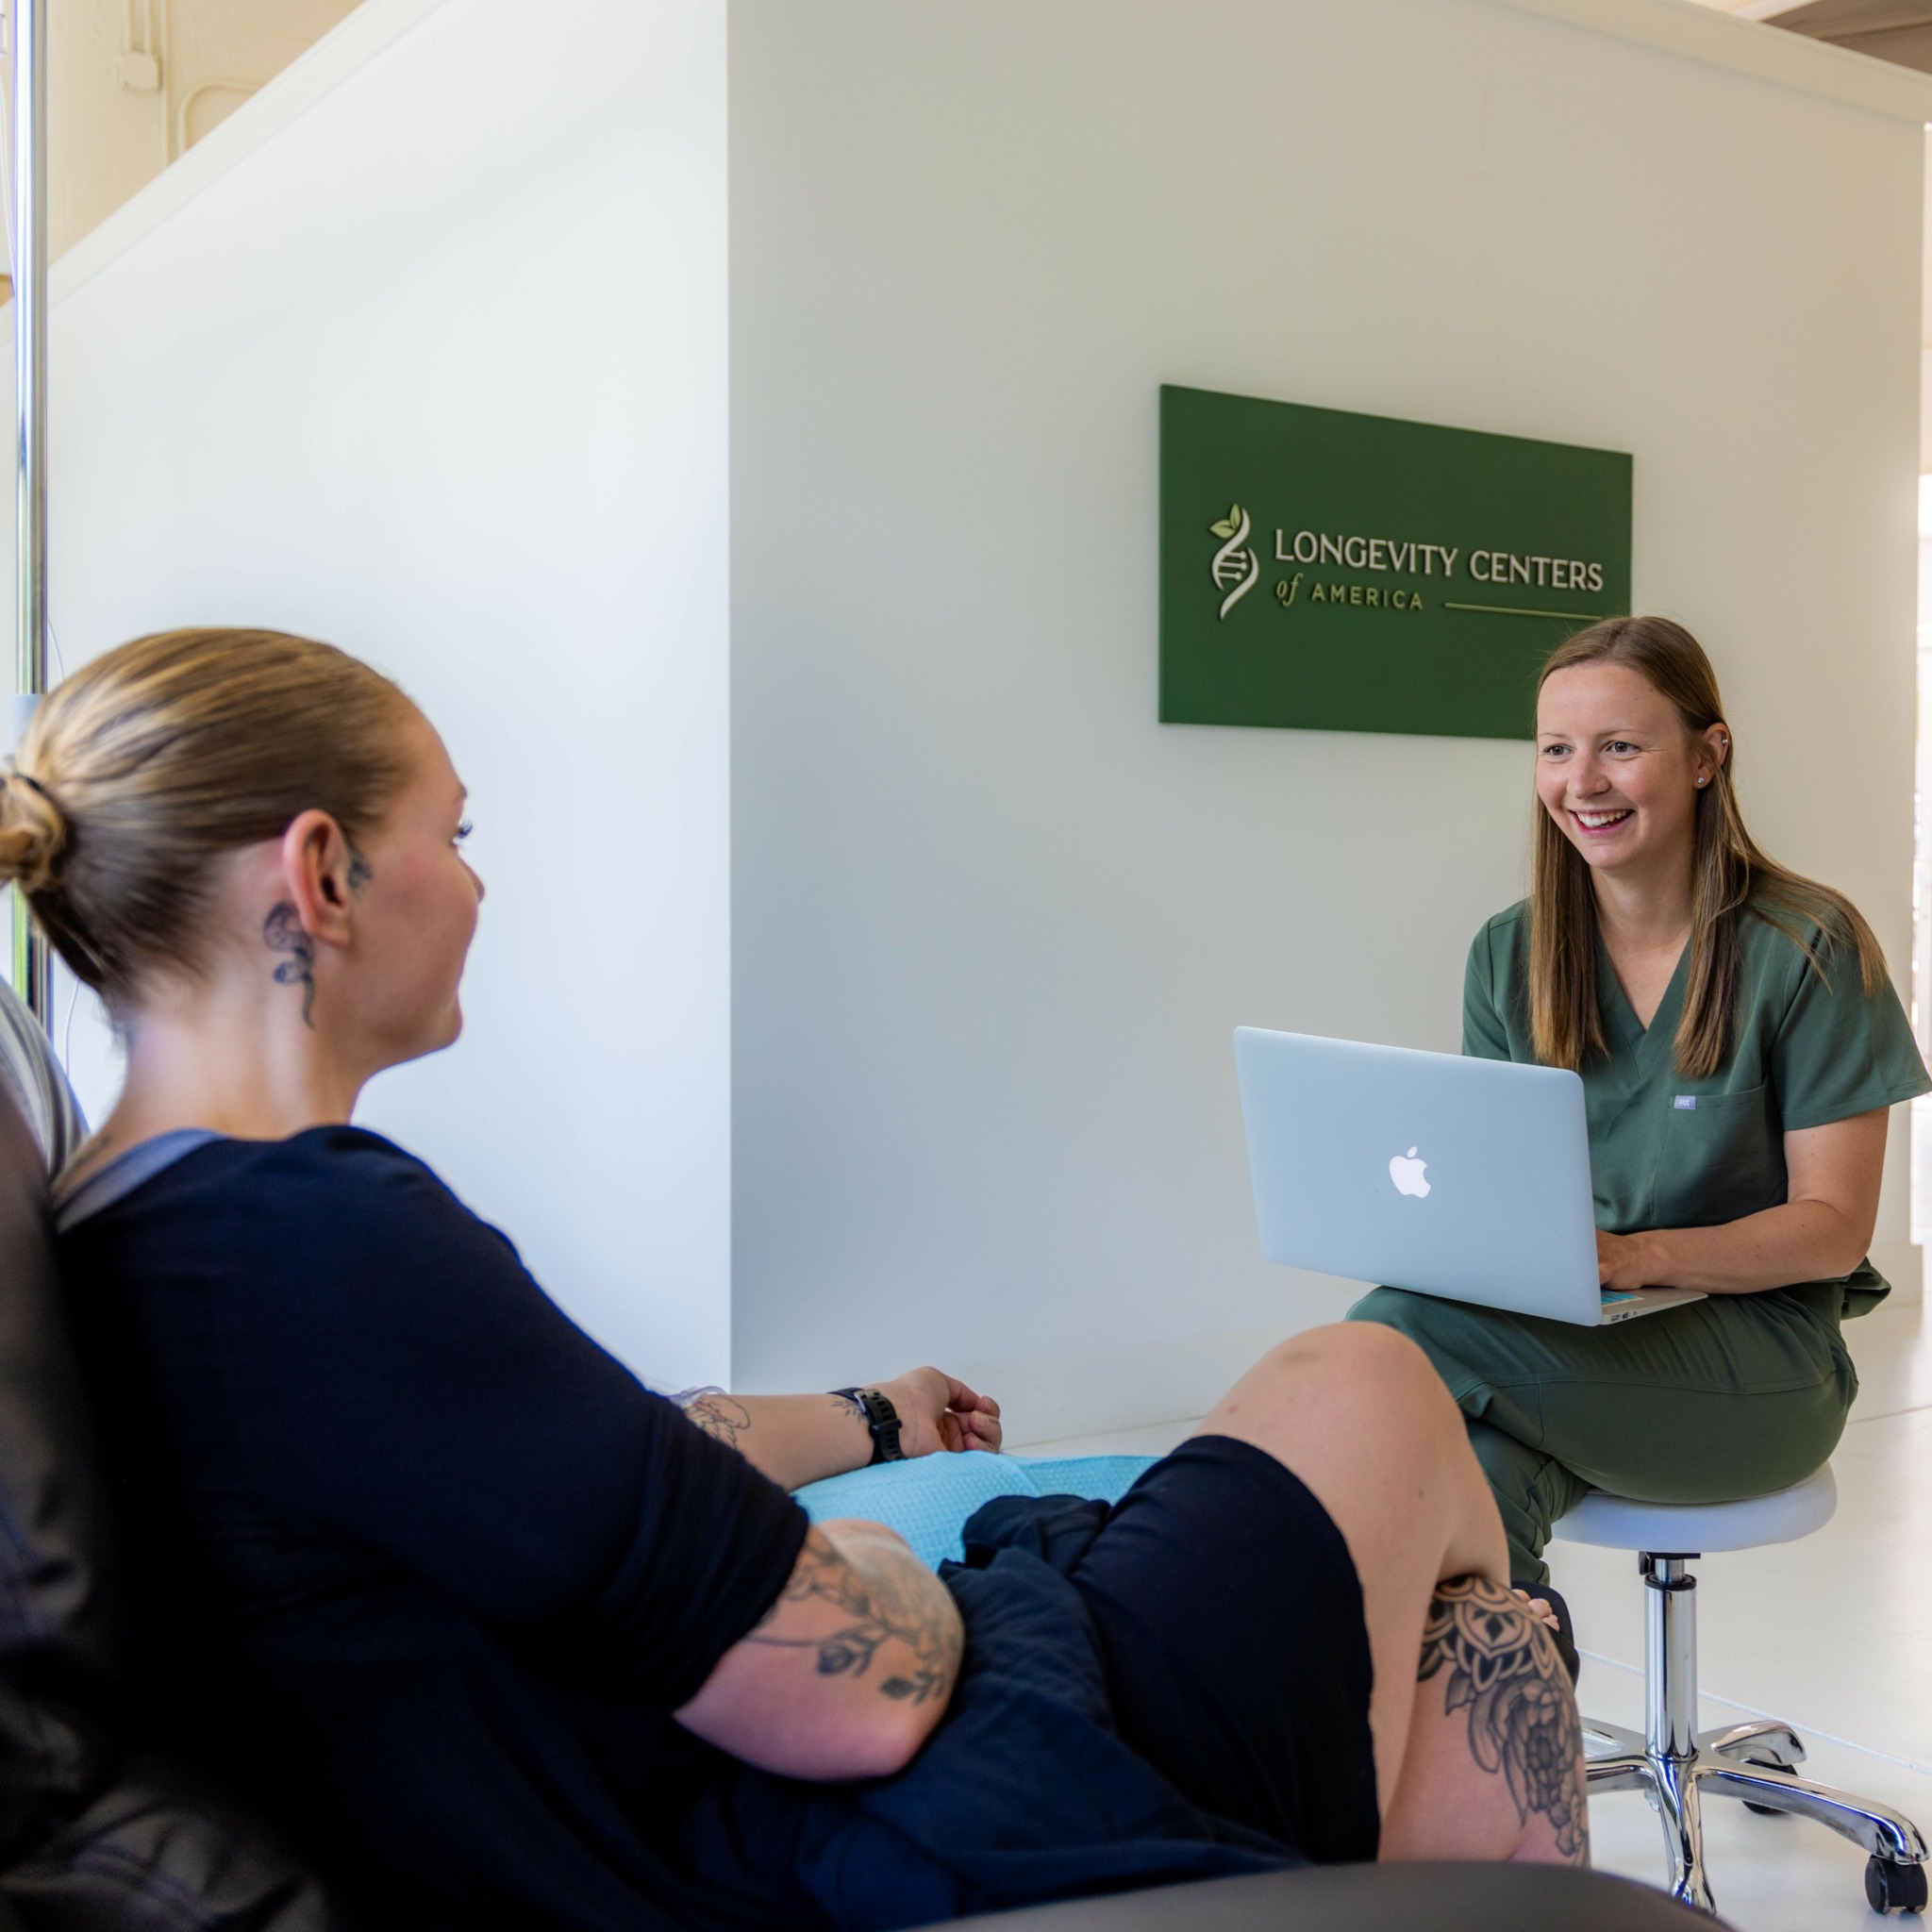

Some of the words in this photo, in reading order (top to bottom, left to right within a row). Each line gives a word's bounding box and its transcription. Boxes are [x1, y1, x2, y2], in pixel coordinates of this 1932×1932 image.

[1275, 529, 1457, 576] LONGEVITY
[1470, 550, 1603, 591] CENTERS
[1276, 573, 1304, 606] of
[1311, 582, 1424, 610] AMERICA
